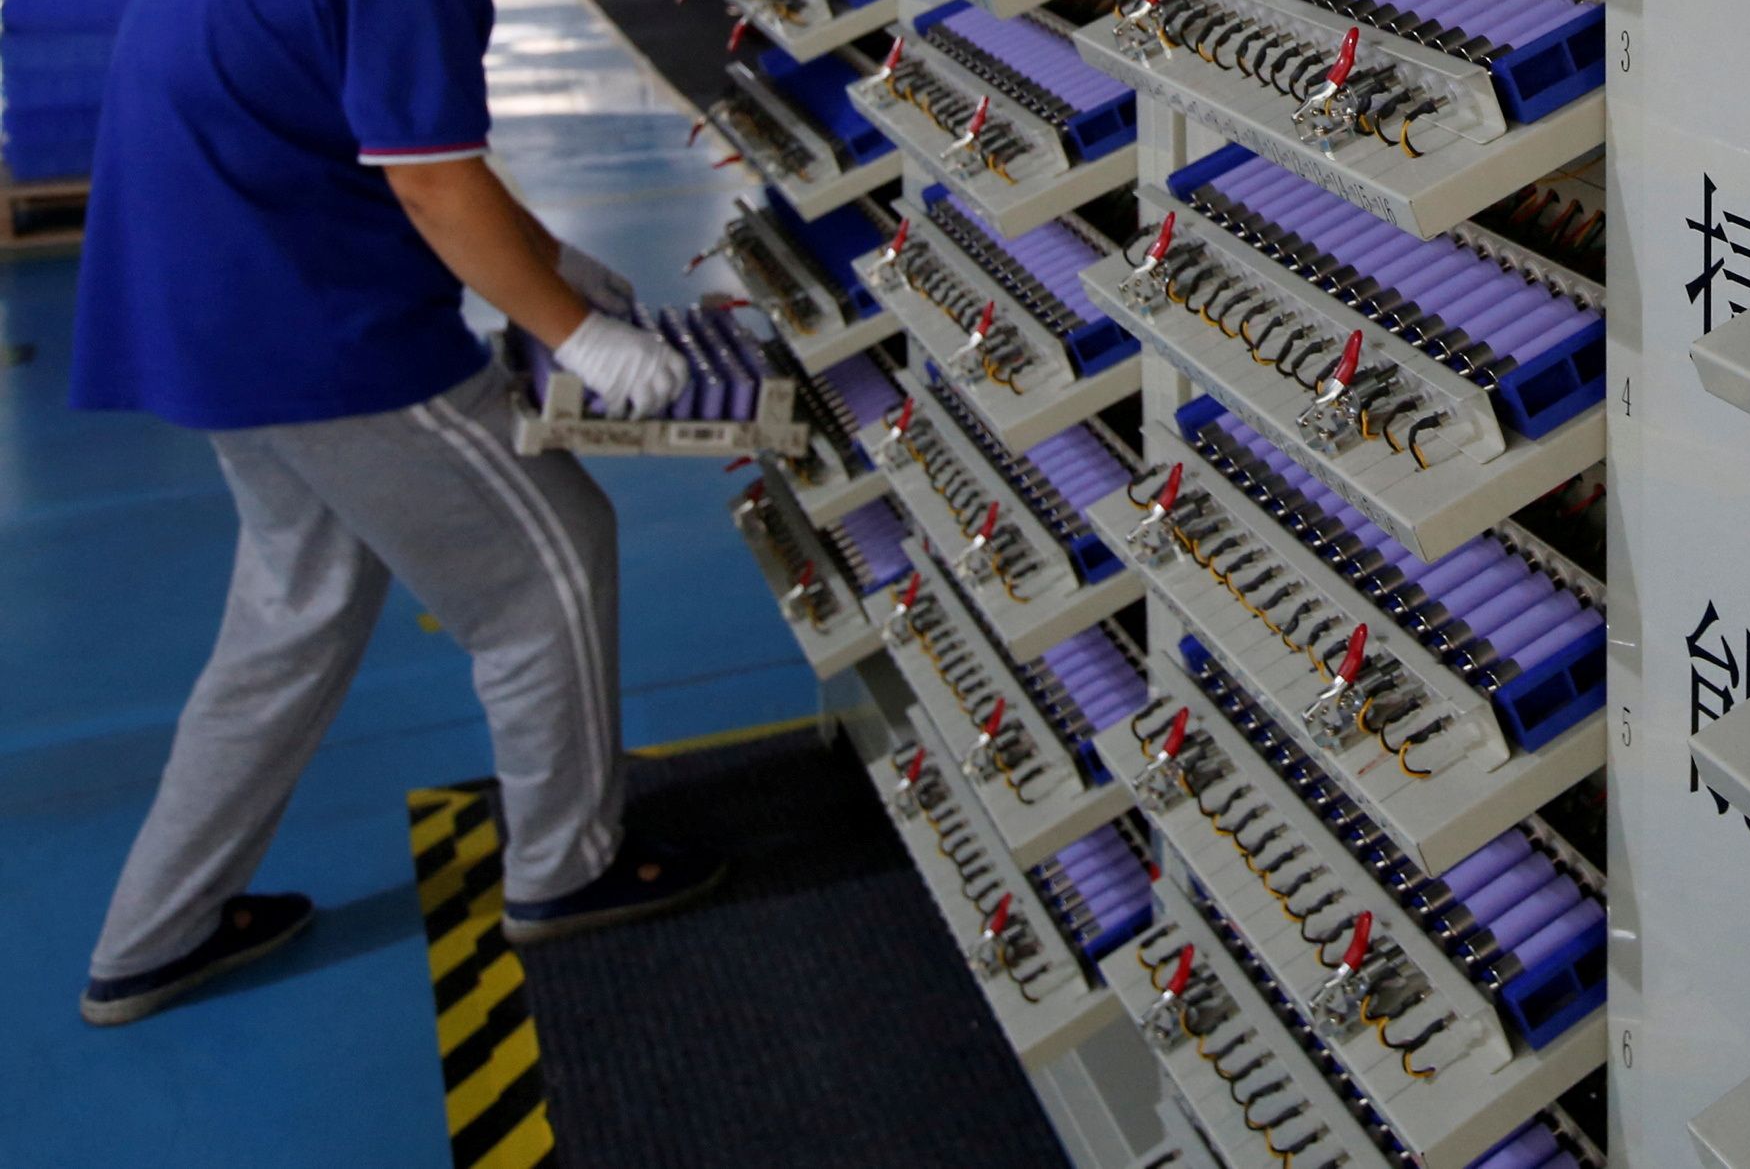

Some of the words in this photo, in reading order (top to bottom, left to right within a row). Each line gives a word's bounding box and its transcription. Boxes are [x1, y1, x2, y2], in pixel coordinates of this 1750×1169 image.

[1621, 30, 1630, 73] 3
[1621, 376, 1632, 417] 4
[1622, 706, 1632, 748] 5
[1622, 1028, 1633, 1070] 6
